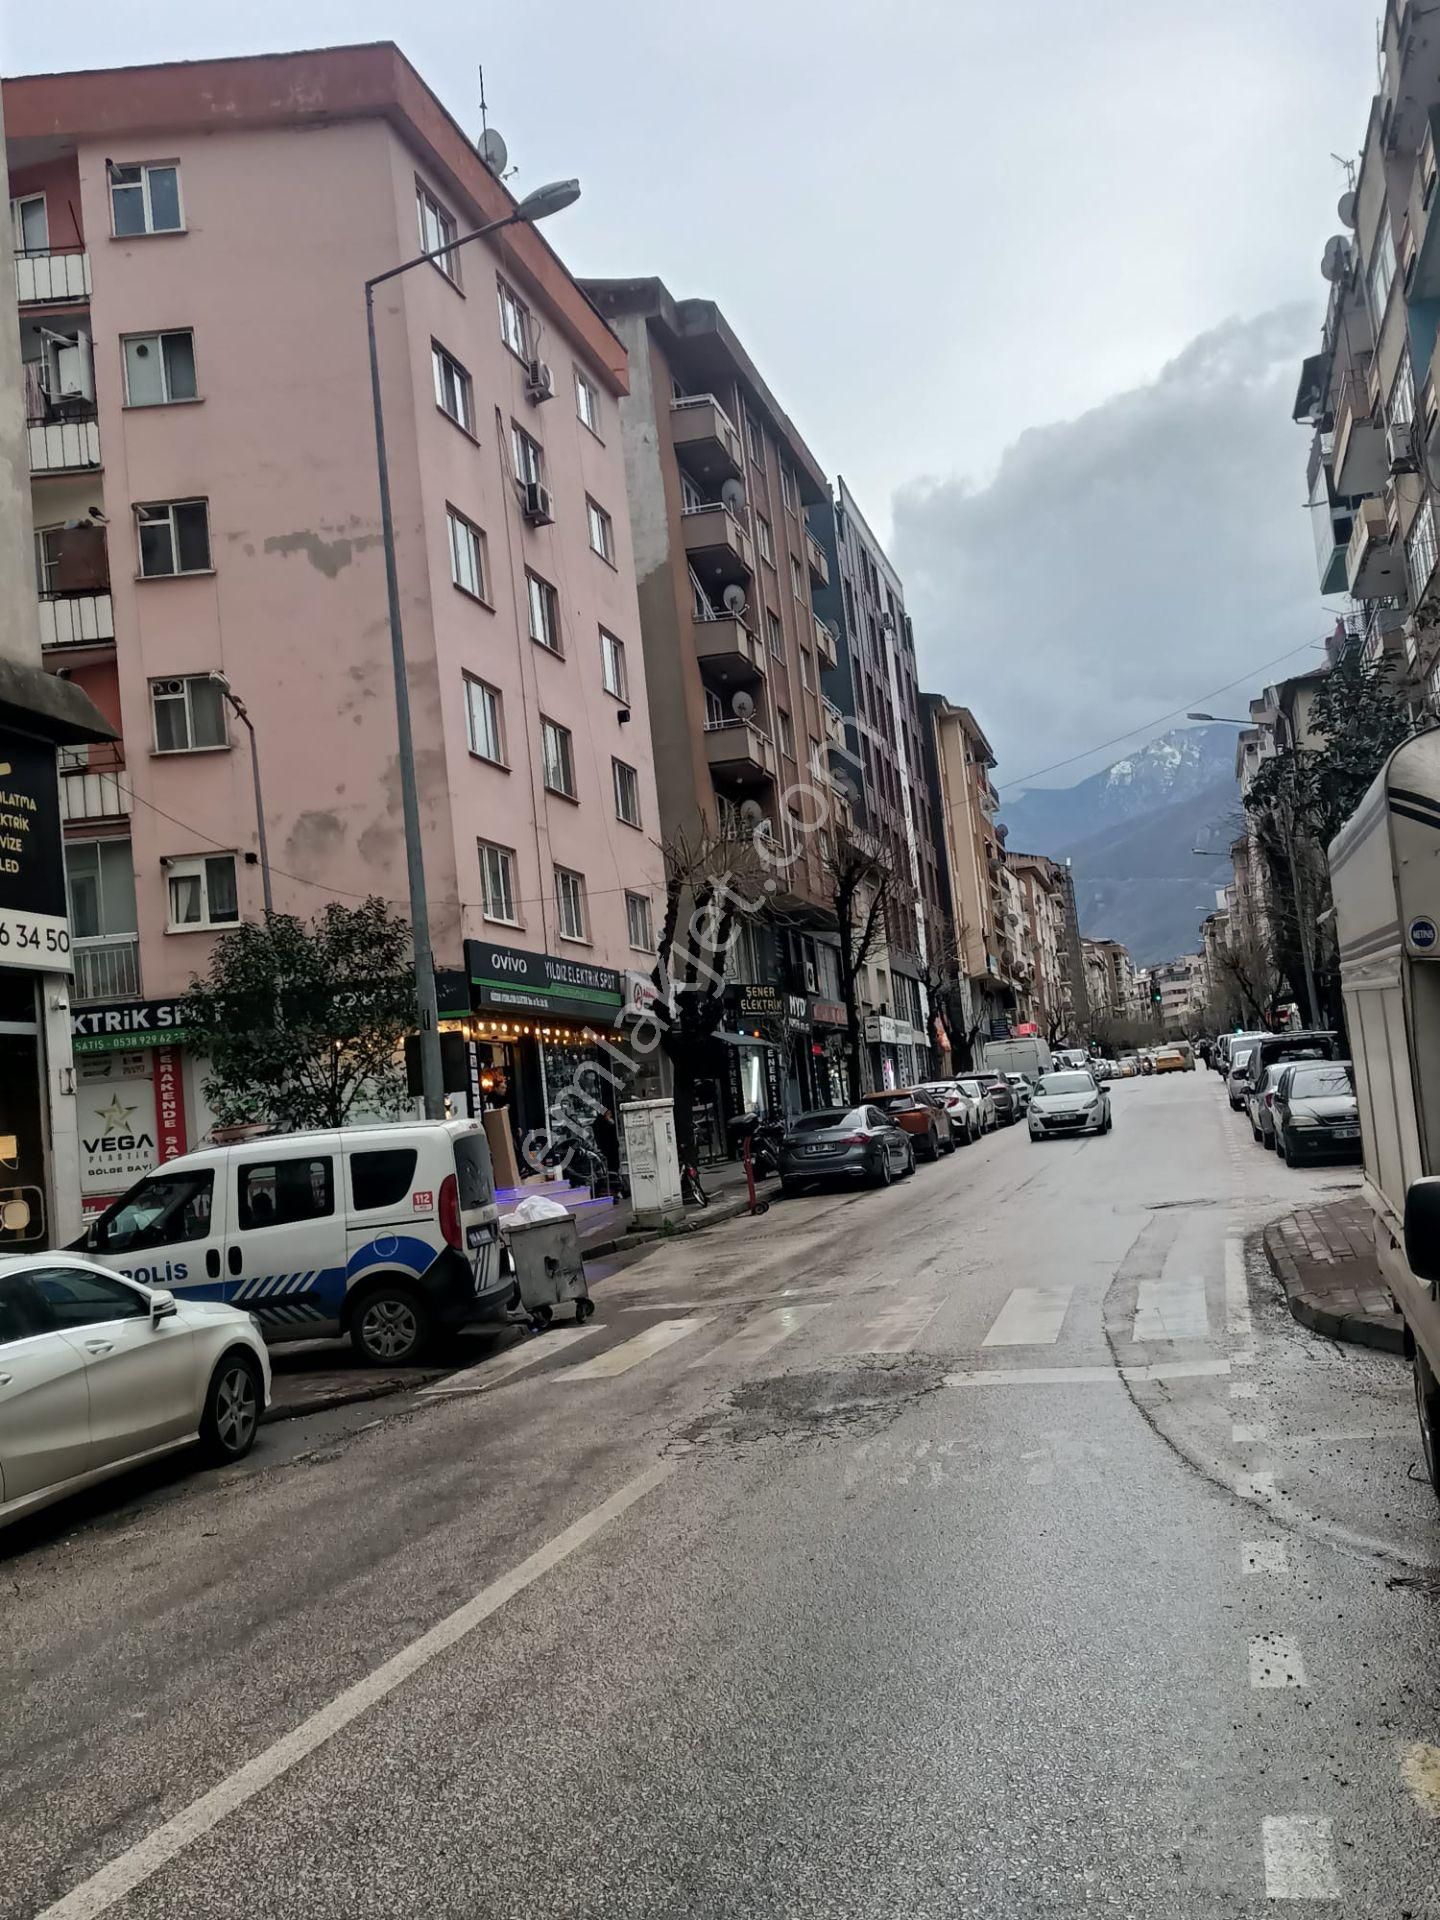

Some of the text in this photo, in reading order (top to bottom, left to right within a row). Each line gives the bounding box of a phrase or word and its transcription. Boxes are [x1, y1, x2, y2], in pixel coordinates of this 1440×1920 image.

[16, 924, 40, 949] 34
[46, 929, 70, 952] 50
[544, 961, 567, 981] YILDIZ
[600, 972, 615, 989] SPOT
[746, 986, 775, 999] ŞENER
[113, 1036, 137, 1047] 0538
[139, 1035, 157, 1045] 929
[159, 1033, 171, 1043] 62
[83, 1134, 154, 1153] VEGA
[415, 1193, 431, 1205] 112
